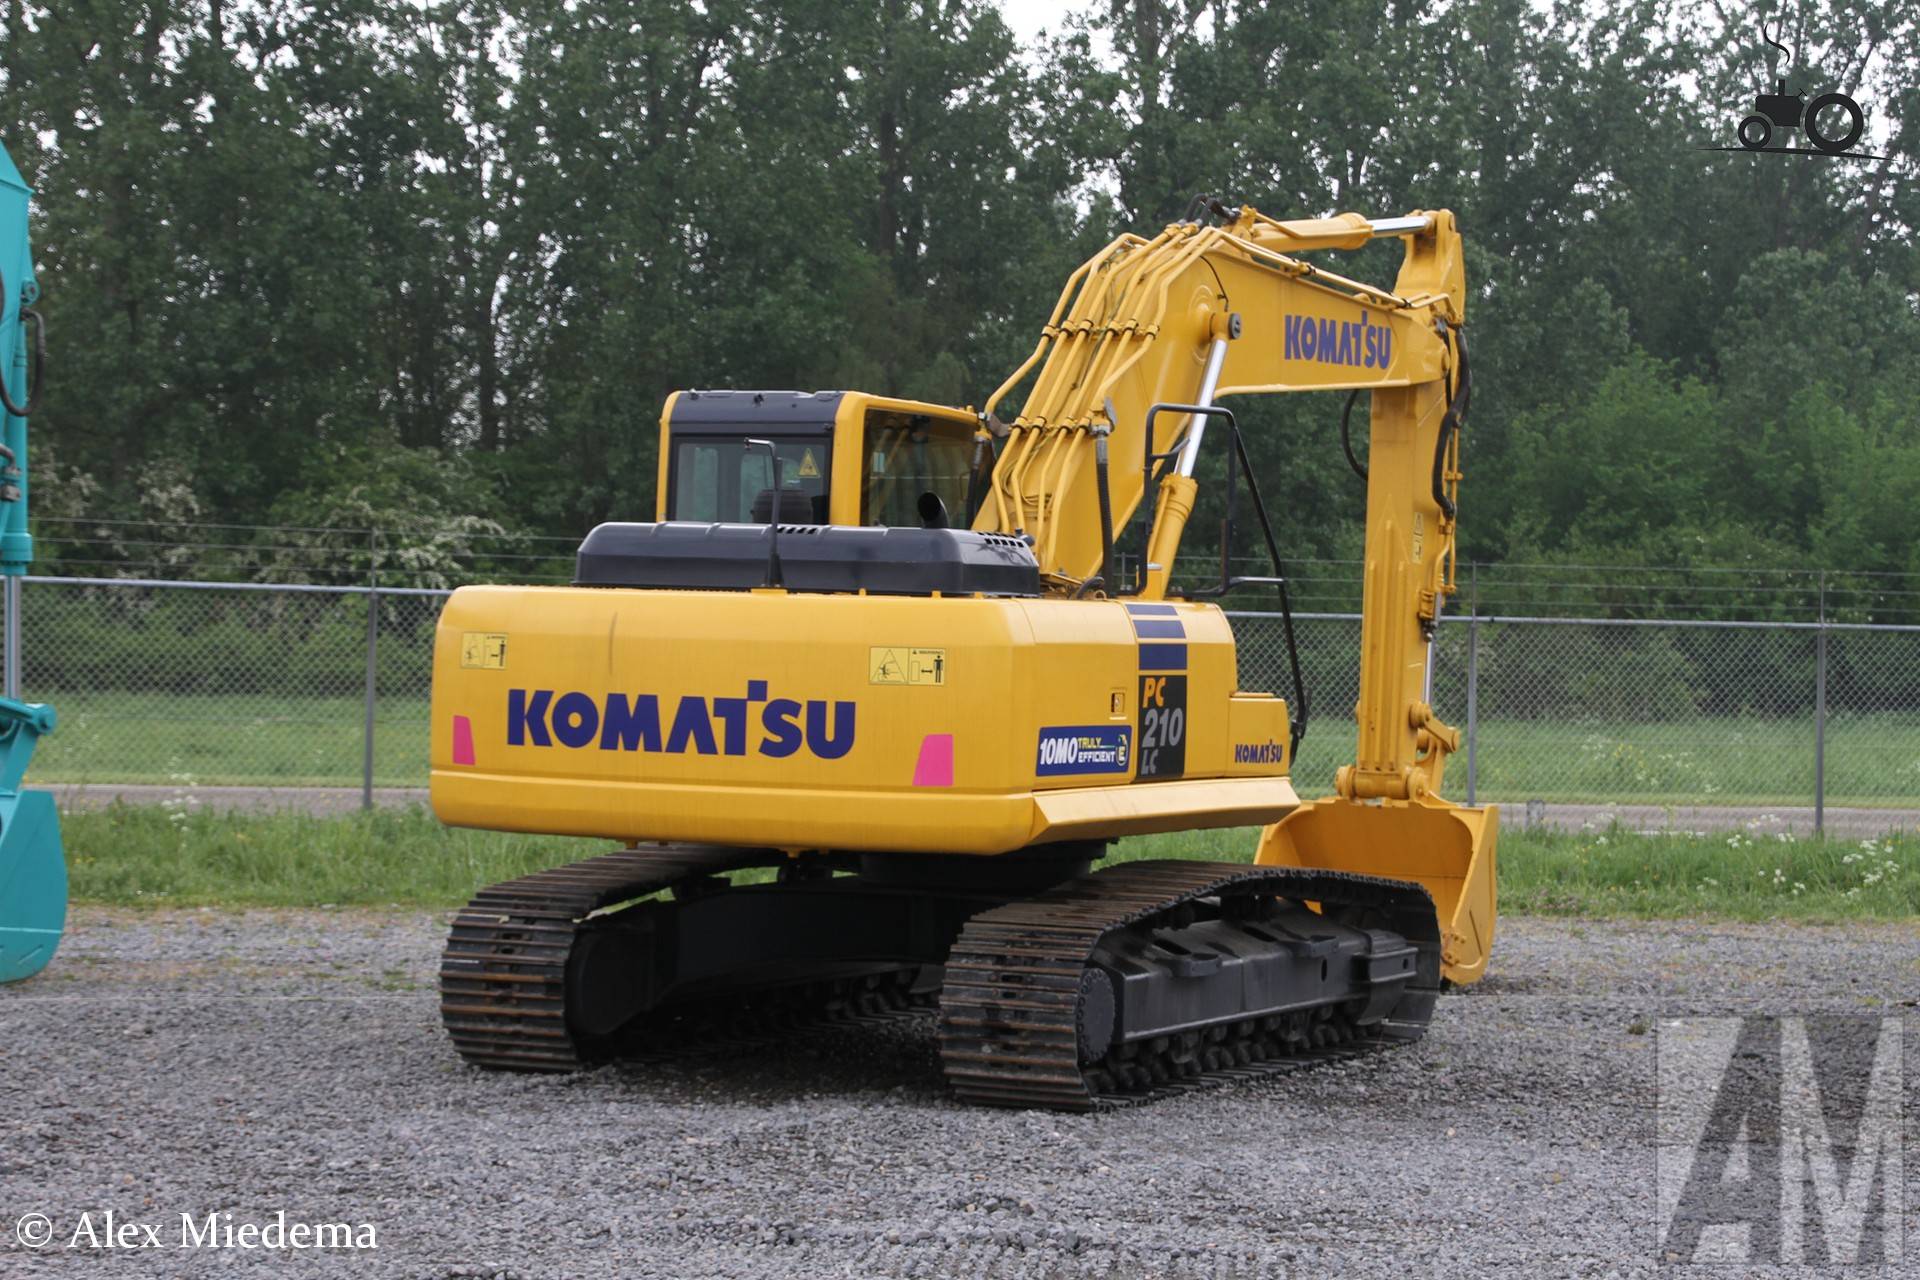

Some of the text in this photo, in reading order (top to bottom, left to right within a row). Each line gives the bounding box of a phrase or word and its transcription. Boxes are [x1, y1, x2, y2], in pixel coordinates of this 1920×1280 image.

[1284, 310, 1391, 369] KOMATSU
[1142, 677, 1166, 708] PC
[507, 680, 856, 759] KOMATSU
[1142, 708, 1184, 748] 210
[1078, 737, 1102, 749] TRULY
[1078, 751, 1116, 763] EFFICIENT
[1234, 739, 1282, 764] KOMATSU
[1140, 749, 1159, 775] LC
